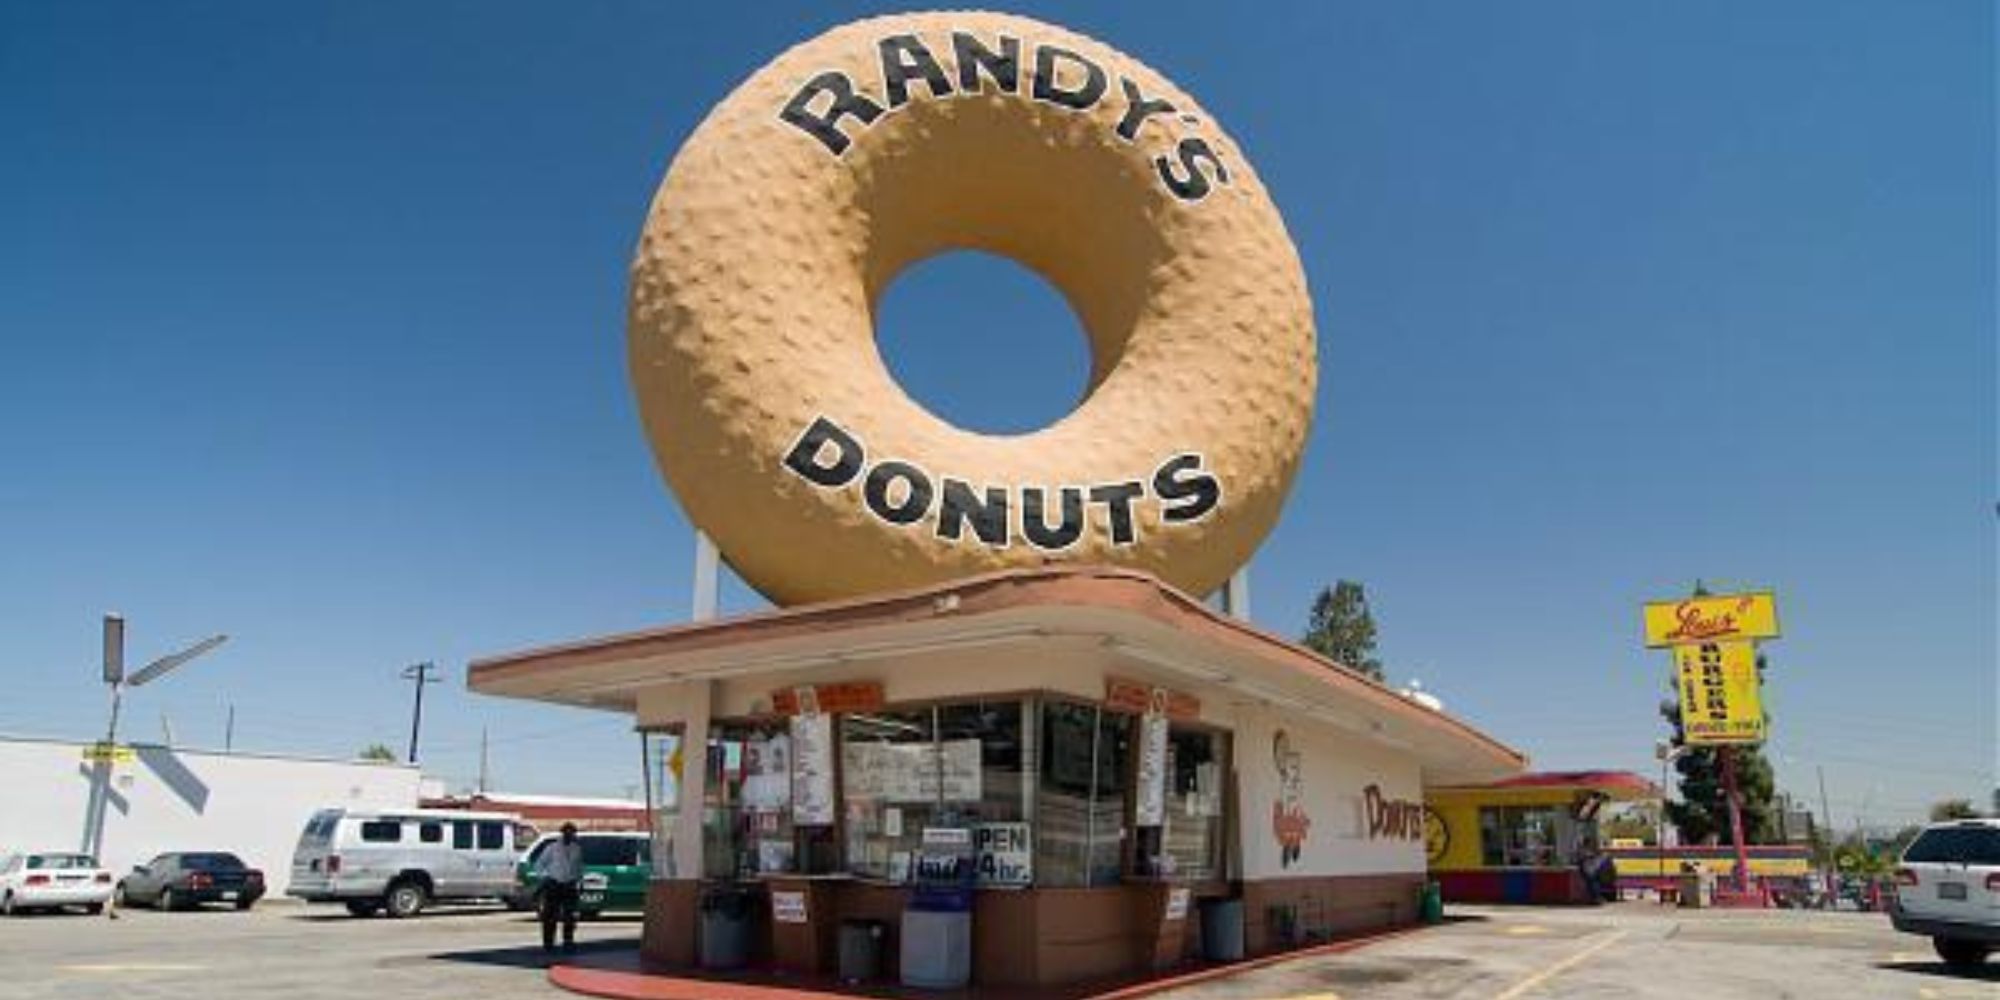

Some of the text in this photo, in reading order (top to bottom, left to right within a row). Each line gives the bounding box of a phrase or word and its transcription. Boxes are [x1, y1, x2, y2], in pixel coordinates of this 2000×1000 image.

[778, 31, 1228, 201] RANDY'S
[782, 415, 1222, 550] DONUTS
[974, 827, 1027, 853] PEN
